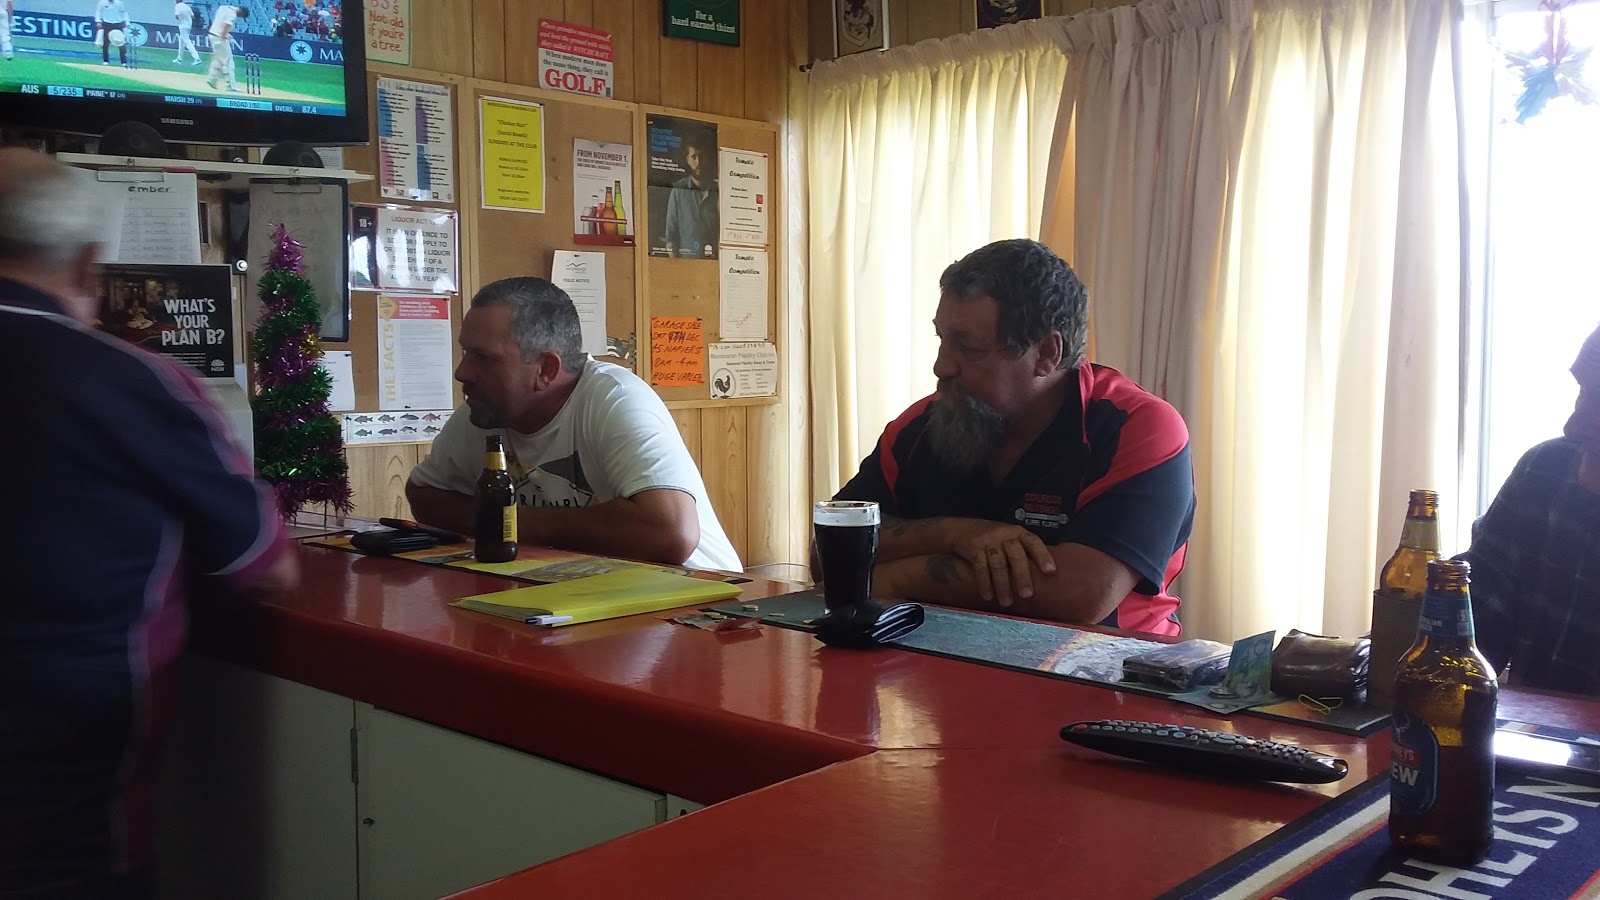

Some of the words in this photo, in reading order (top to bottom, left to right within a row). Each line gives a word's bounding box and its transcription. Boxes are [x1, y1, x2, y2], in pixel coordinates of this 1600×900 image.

[544, 68, 606, 96] GOLF
[20, 84, 40, 94] AUS
[52, 86, 78, 96] 5/235
[160, 118, 194, 126] SAMSUNG
[576, 149, 592, 158] FROM
[593, 152, 623, 162] NOVEMBER
[128, 184, 172, 194] ember
[391, 216, 415, 224] LIQUOR
[164, 298, 216, 314] WHAT'S
[173, 314, 210, 329] YOUR
[653, 320, 685, 329] GARAGE
[161, 330, 200, 346] PLAN
[206, 328, 226, 346] B?
[384, 324, 396, 370] FACTS
[652, 372, 676, 381] HUGE
[384, 376, 396, 402] THE
